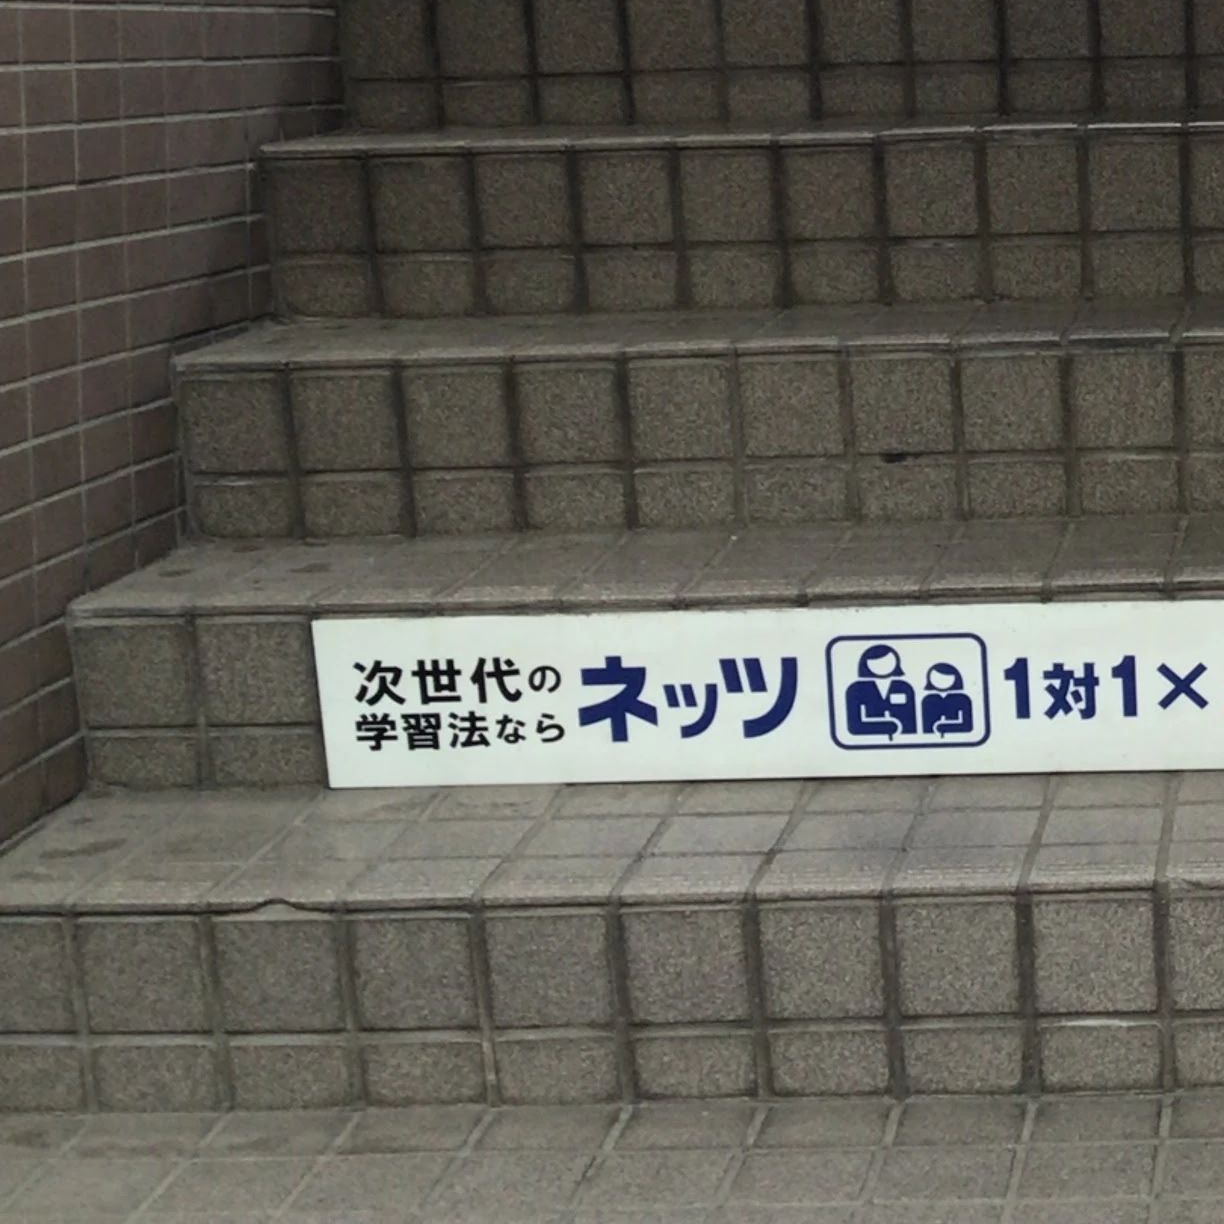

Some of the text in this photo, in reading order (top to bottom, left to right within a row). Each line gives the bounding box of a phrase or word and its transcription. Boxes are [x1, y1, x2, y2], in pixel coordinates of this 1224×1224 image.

[353, 656, 562, 706] 次世代の
[578, 655, 798, 742] ネッツ
[355, 711, 566, 751] 学習法なら
